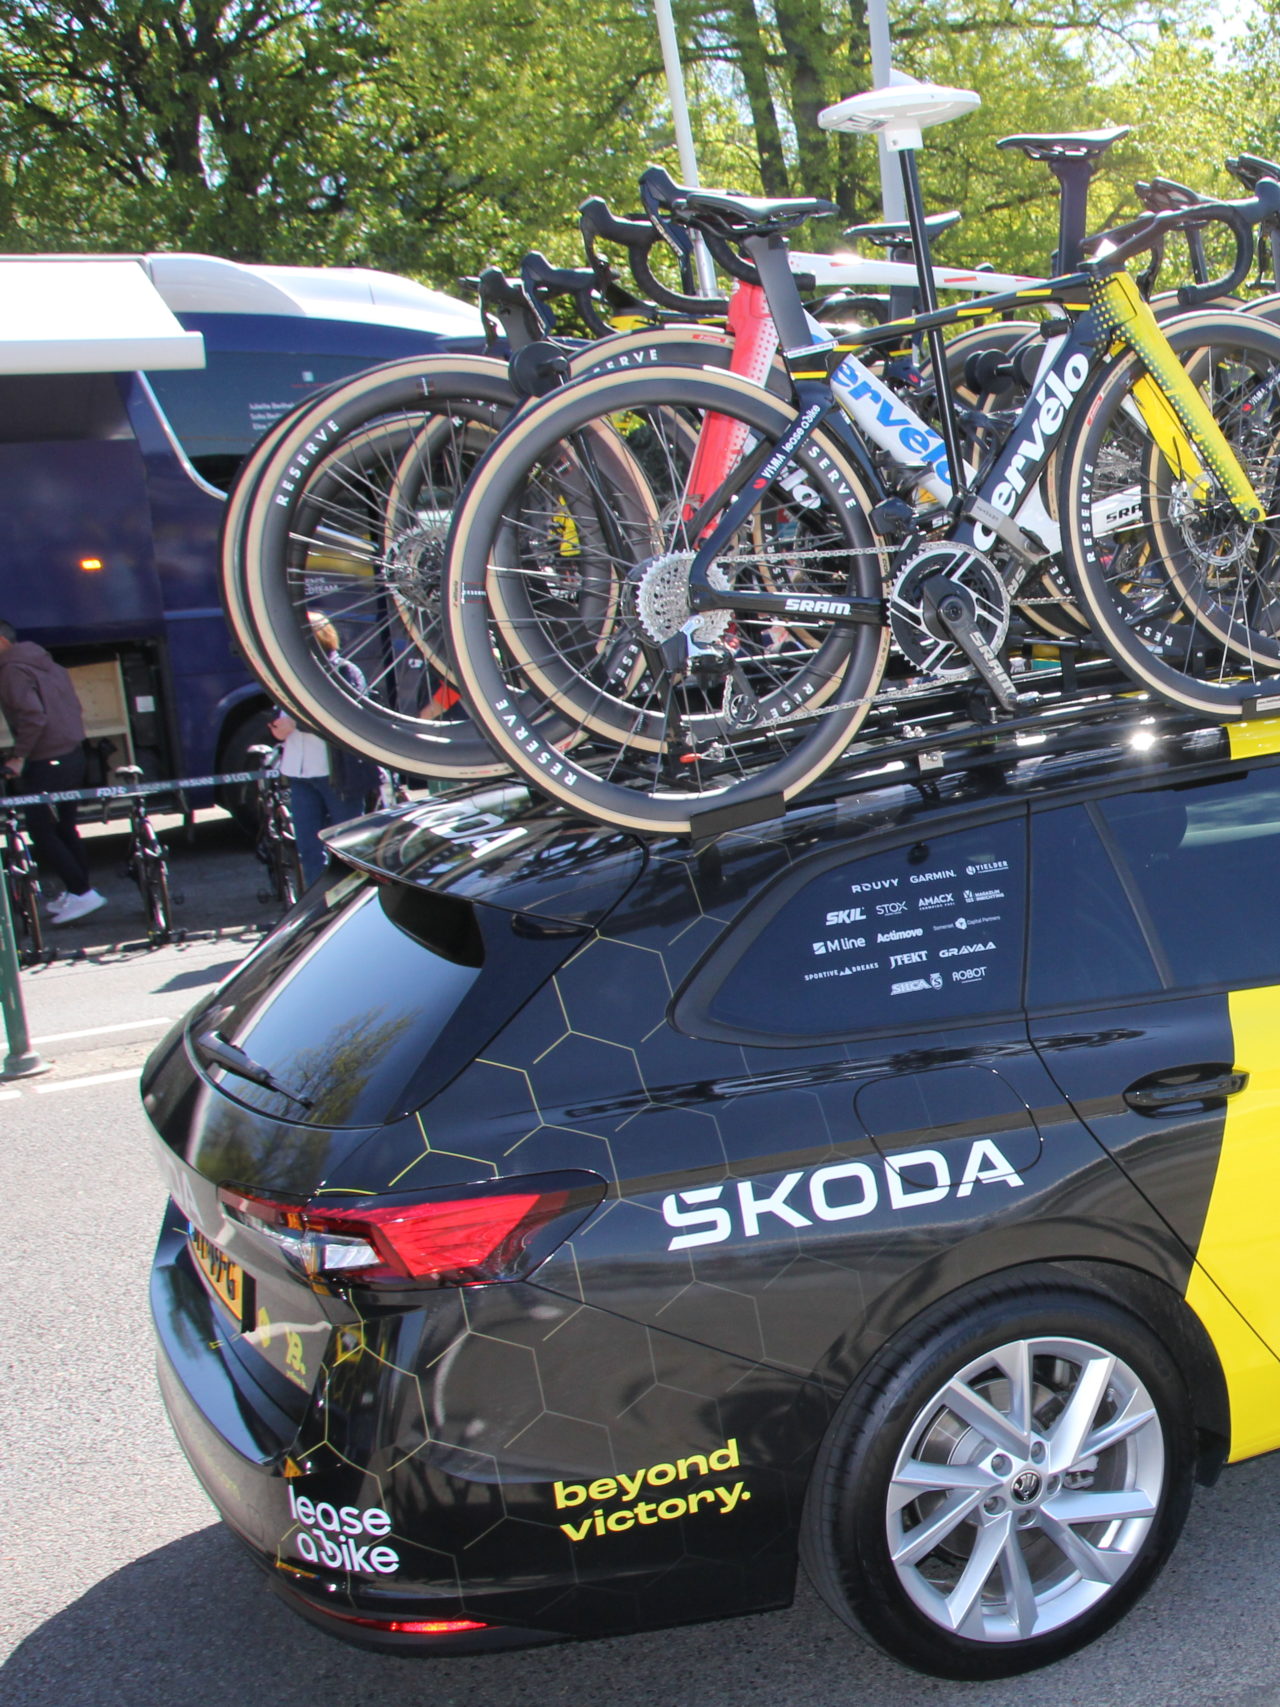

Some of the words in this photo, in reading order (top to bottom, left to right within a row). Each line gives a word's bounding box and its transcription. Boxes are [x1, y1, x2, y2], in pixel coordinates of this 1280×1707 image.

[275, 419, 341, 506] RESERVE
[761, 453, 786, 478] VISMA
[782, 427, 804, 453] lease
[1080, 463, 1095, 563] RESERVE
[785, 599, 851, 615] SRAM
[969, 632, 1017, 694] SRAM
[496, 698, 577, 786] RESERVE
[851, 878, 899, 893] ROUVY
[975, 860, 1009, 872] YIELDER
[825, 907, 866, 926] SKIL
[876, 901, 908, 915] STOX
[918, 893, 954, 907] AMACX
[877, 928, 923, 944] Actimove
[804, 969, 839, 981] SPORTIVE
[852, 962, 879, 973] BREAKS
[889, 950, 928, 969] JTEKT
[952, 967, 987, 982] ROBOT
[553, 1438, 741, 1510] beyond
[287, 1484, 392, 1537] lease
[560, 1482, 752, 1542] victory.
